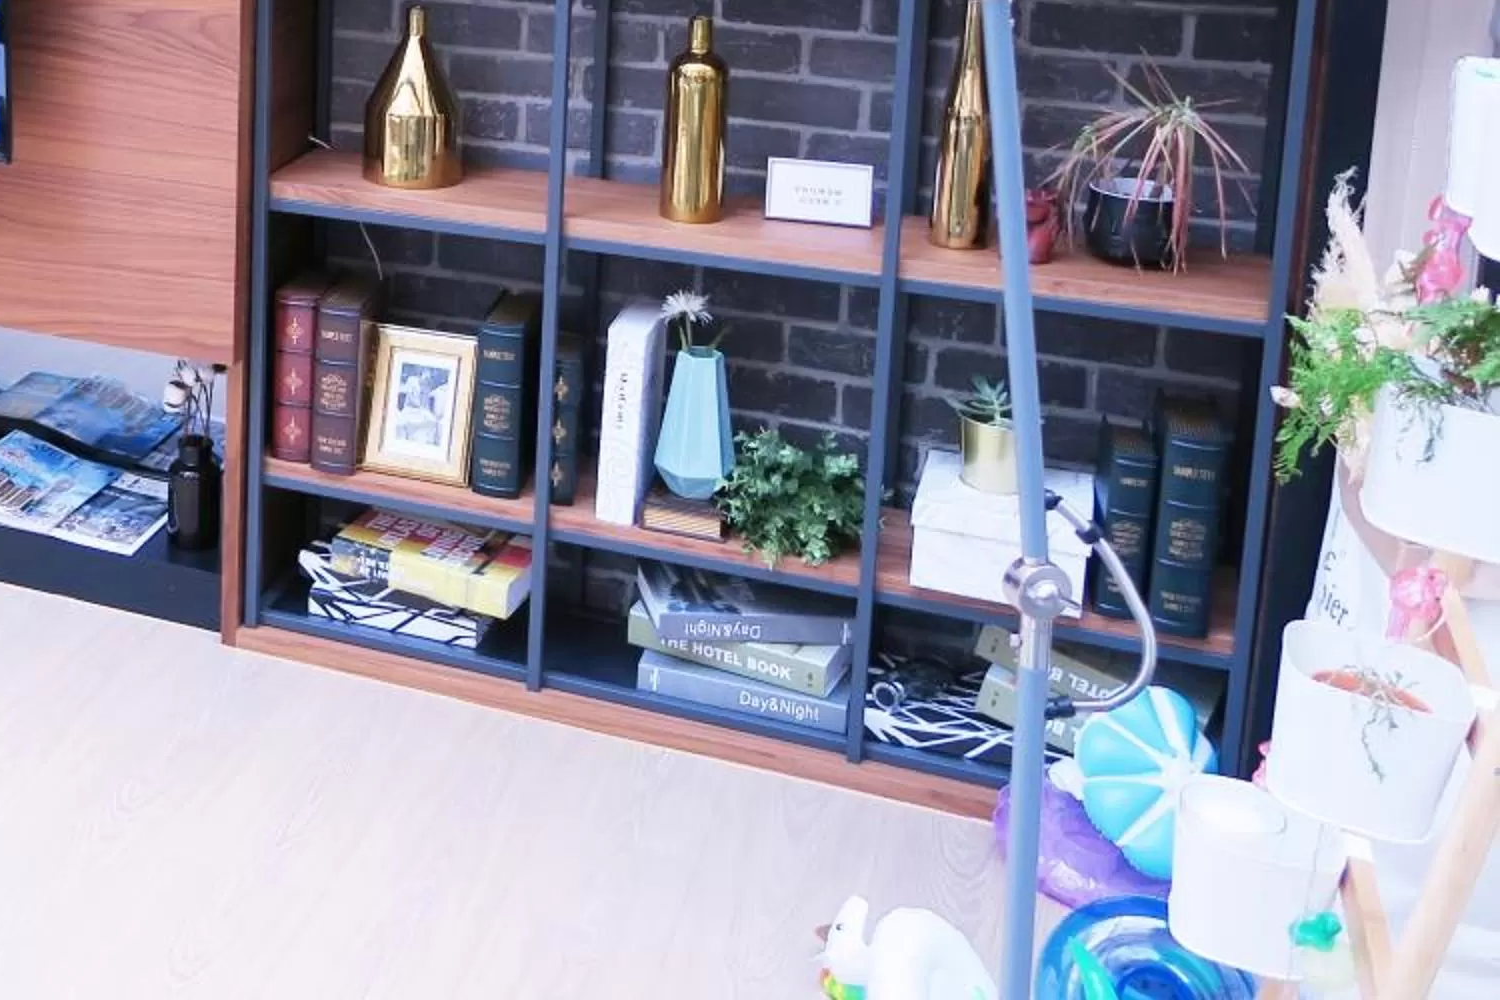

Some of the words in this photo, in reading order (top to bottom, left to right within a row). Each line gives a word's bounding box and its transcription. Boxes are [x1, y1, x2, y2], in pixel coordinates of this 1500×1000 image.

[684, 618, 762, 640] Day&Night
[692, 642, 743, 668] HOTEL
[747, 656, 792, 681] BOOK
[1068, 672, 1111, 698] OTEL
[739, 690, 820, 723] Day&Night
